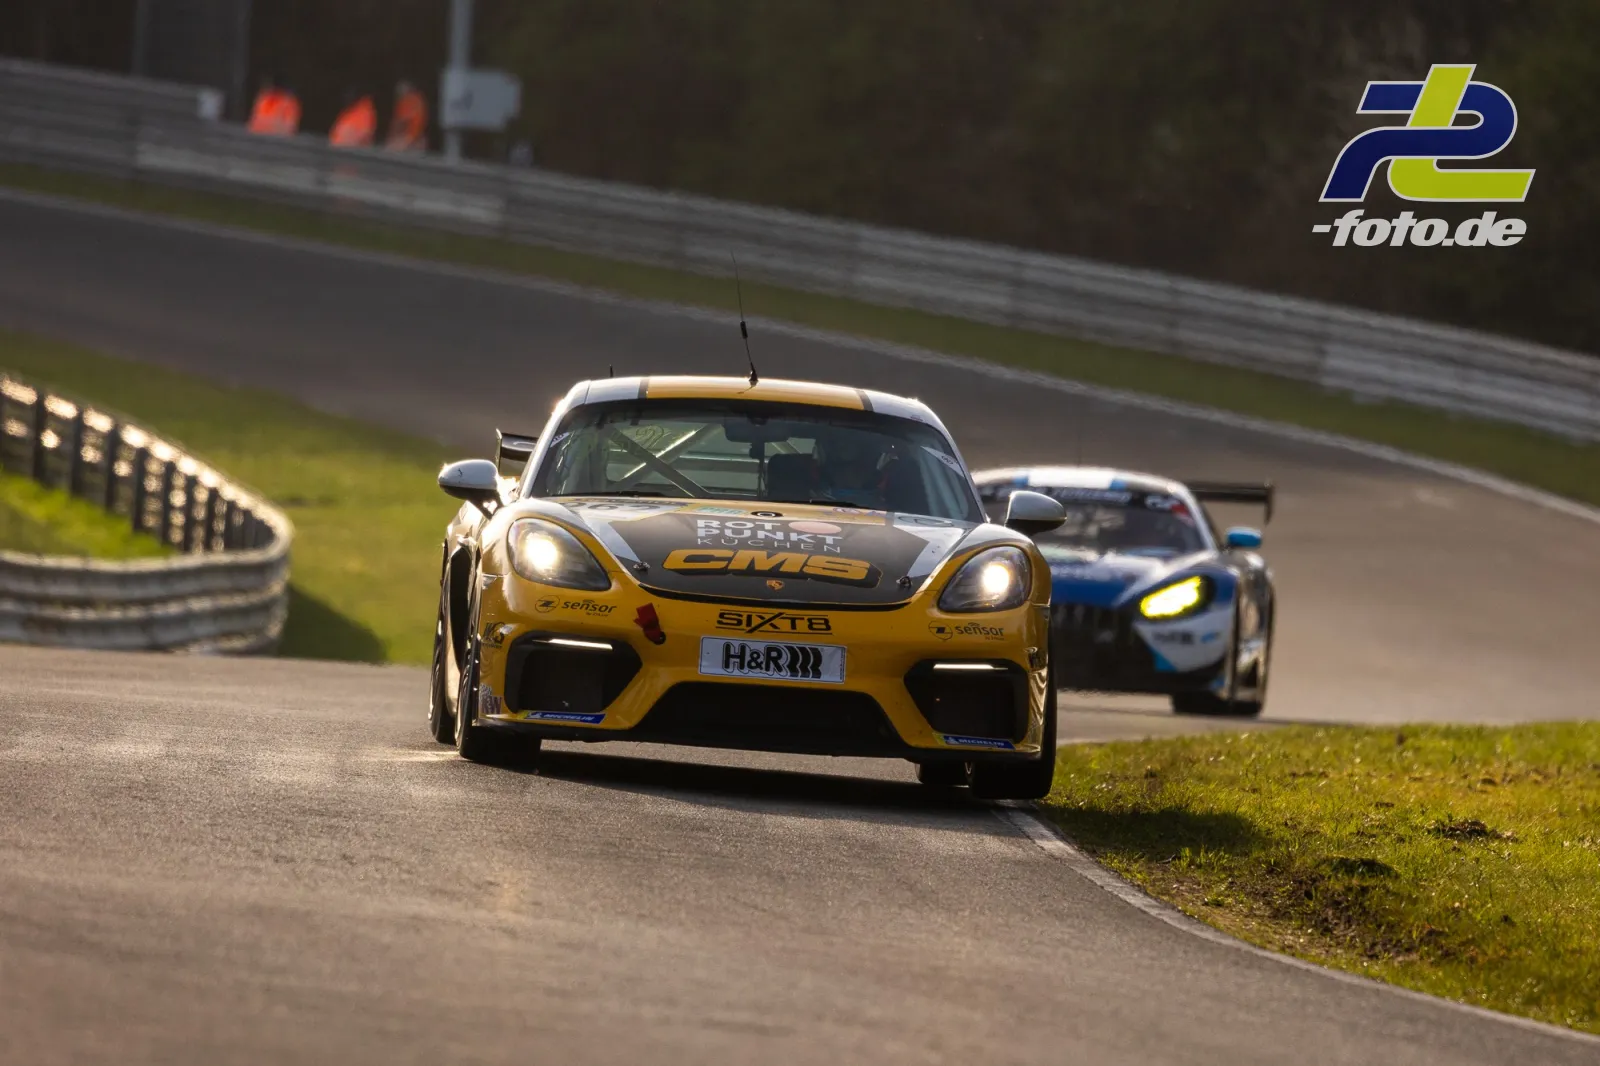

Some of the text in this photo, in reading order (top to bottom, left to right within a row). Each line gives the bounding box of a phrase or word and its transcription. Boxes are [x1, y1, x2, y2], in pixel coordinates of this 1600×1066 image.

[697, 519, 781, 531] ROT
[697, 528, 843, 545] PUNKT
[697, 537, 841, 553] KÜCHEN
[663, 549, 871, 581] CMS
[561, 600, 618, 614] sensor
[716, 612, 832, 634] SIXT8
[954, 625, 1005, 637] sensor
[722, 641, 788, 675] H&R
[543, 713, 595, 722] MICHELIN
[958, 738, 1005, 747] MICHELIN
